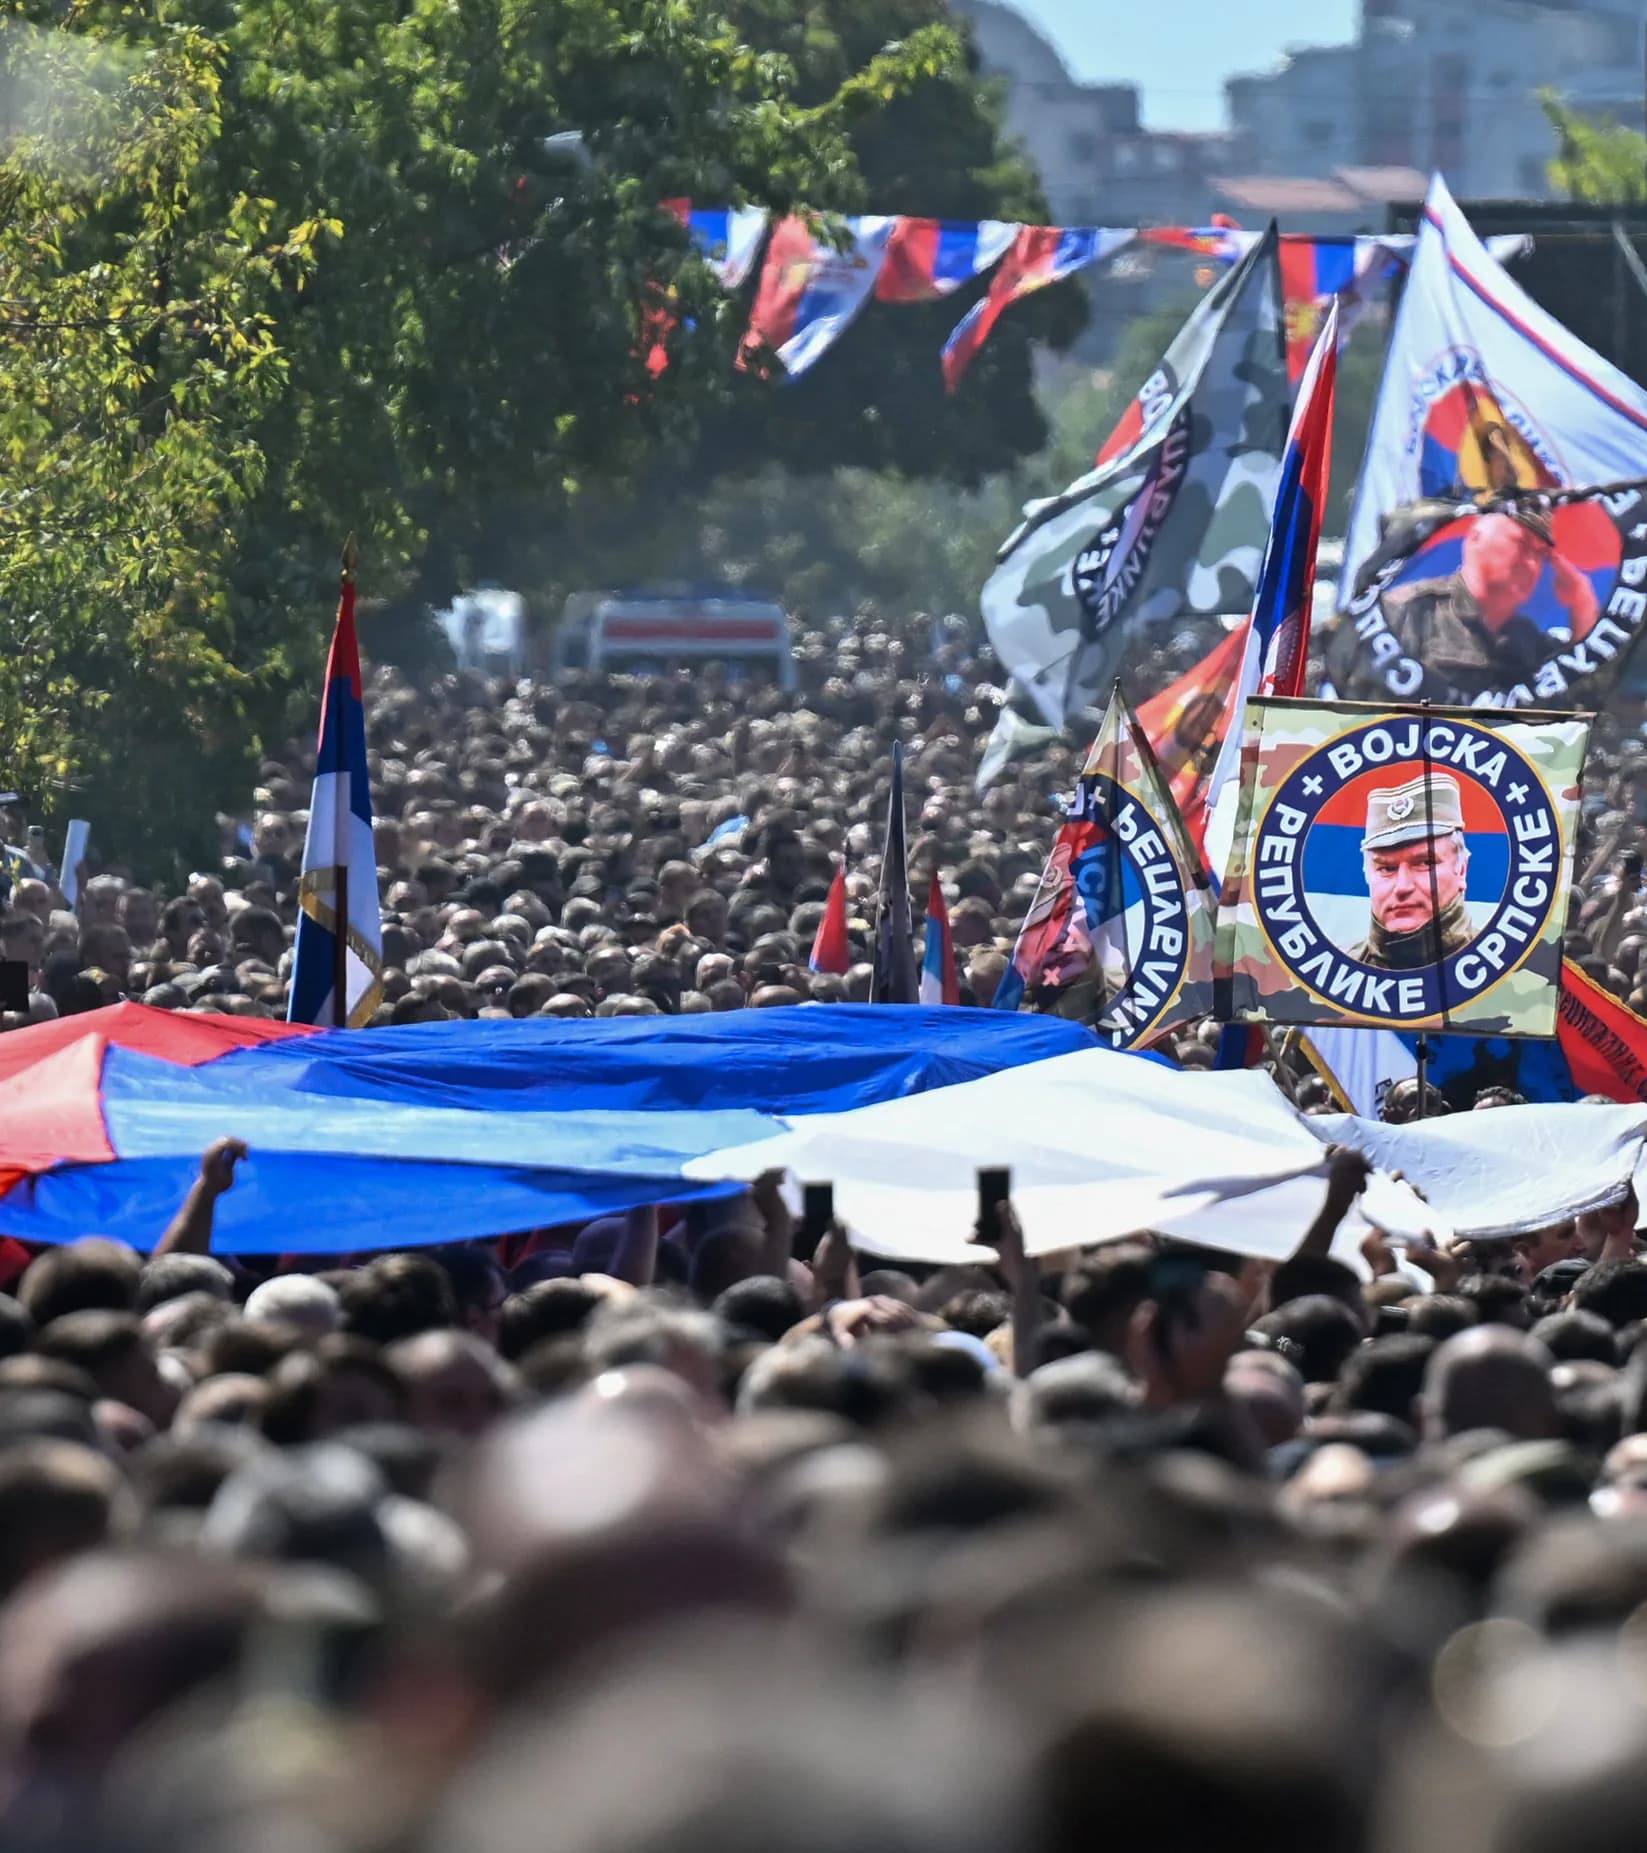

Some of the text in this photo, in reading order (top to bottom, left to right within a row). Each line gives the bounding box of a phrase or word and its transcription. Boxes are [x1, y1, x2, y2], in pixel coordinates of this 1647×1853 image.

[1327, 724, 1511, 788] ВОЈСКА
[1259, 802, 1553, 1014] РЕПУБЛИКЕ СРПСКЕ
